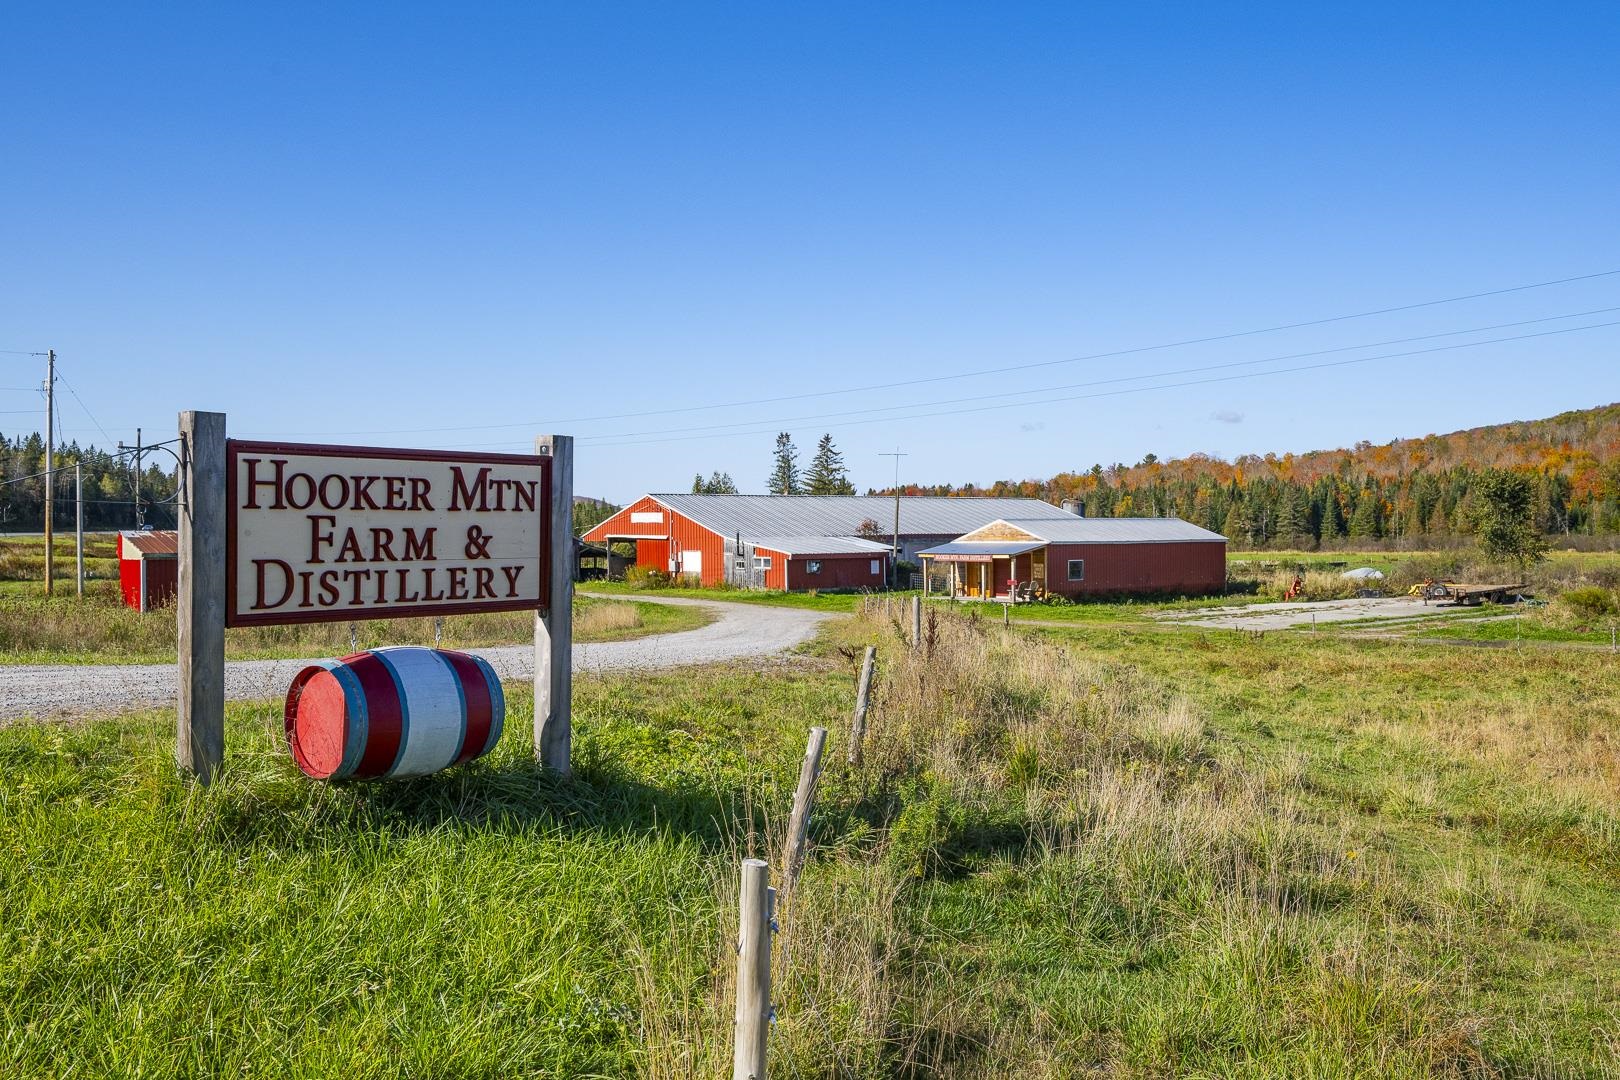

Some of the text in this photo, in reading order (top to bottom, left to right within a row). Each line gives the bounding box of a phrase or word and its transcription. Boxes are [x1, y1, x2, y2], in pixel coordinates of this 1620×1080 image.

[242, 458, 538, 512] HOOKER MTN
[306, 515, 494, 564] FARM &
[250, 559, 524, 610] DISTILLERY
